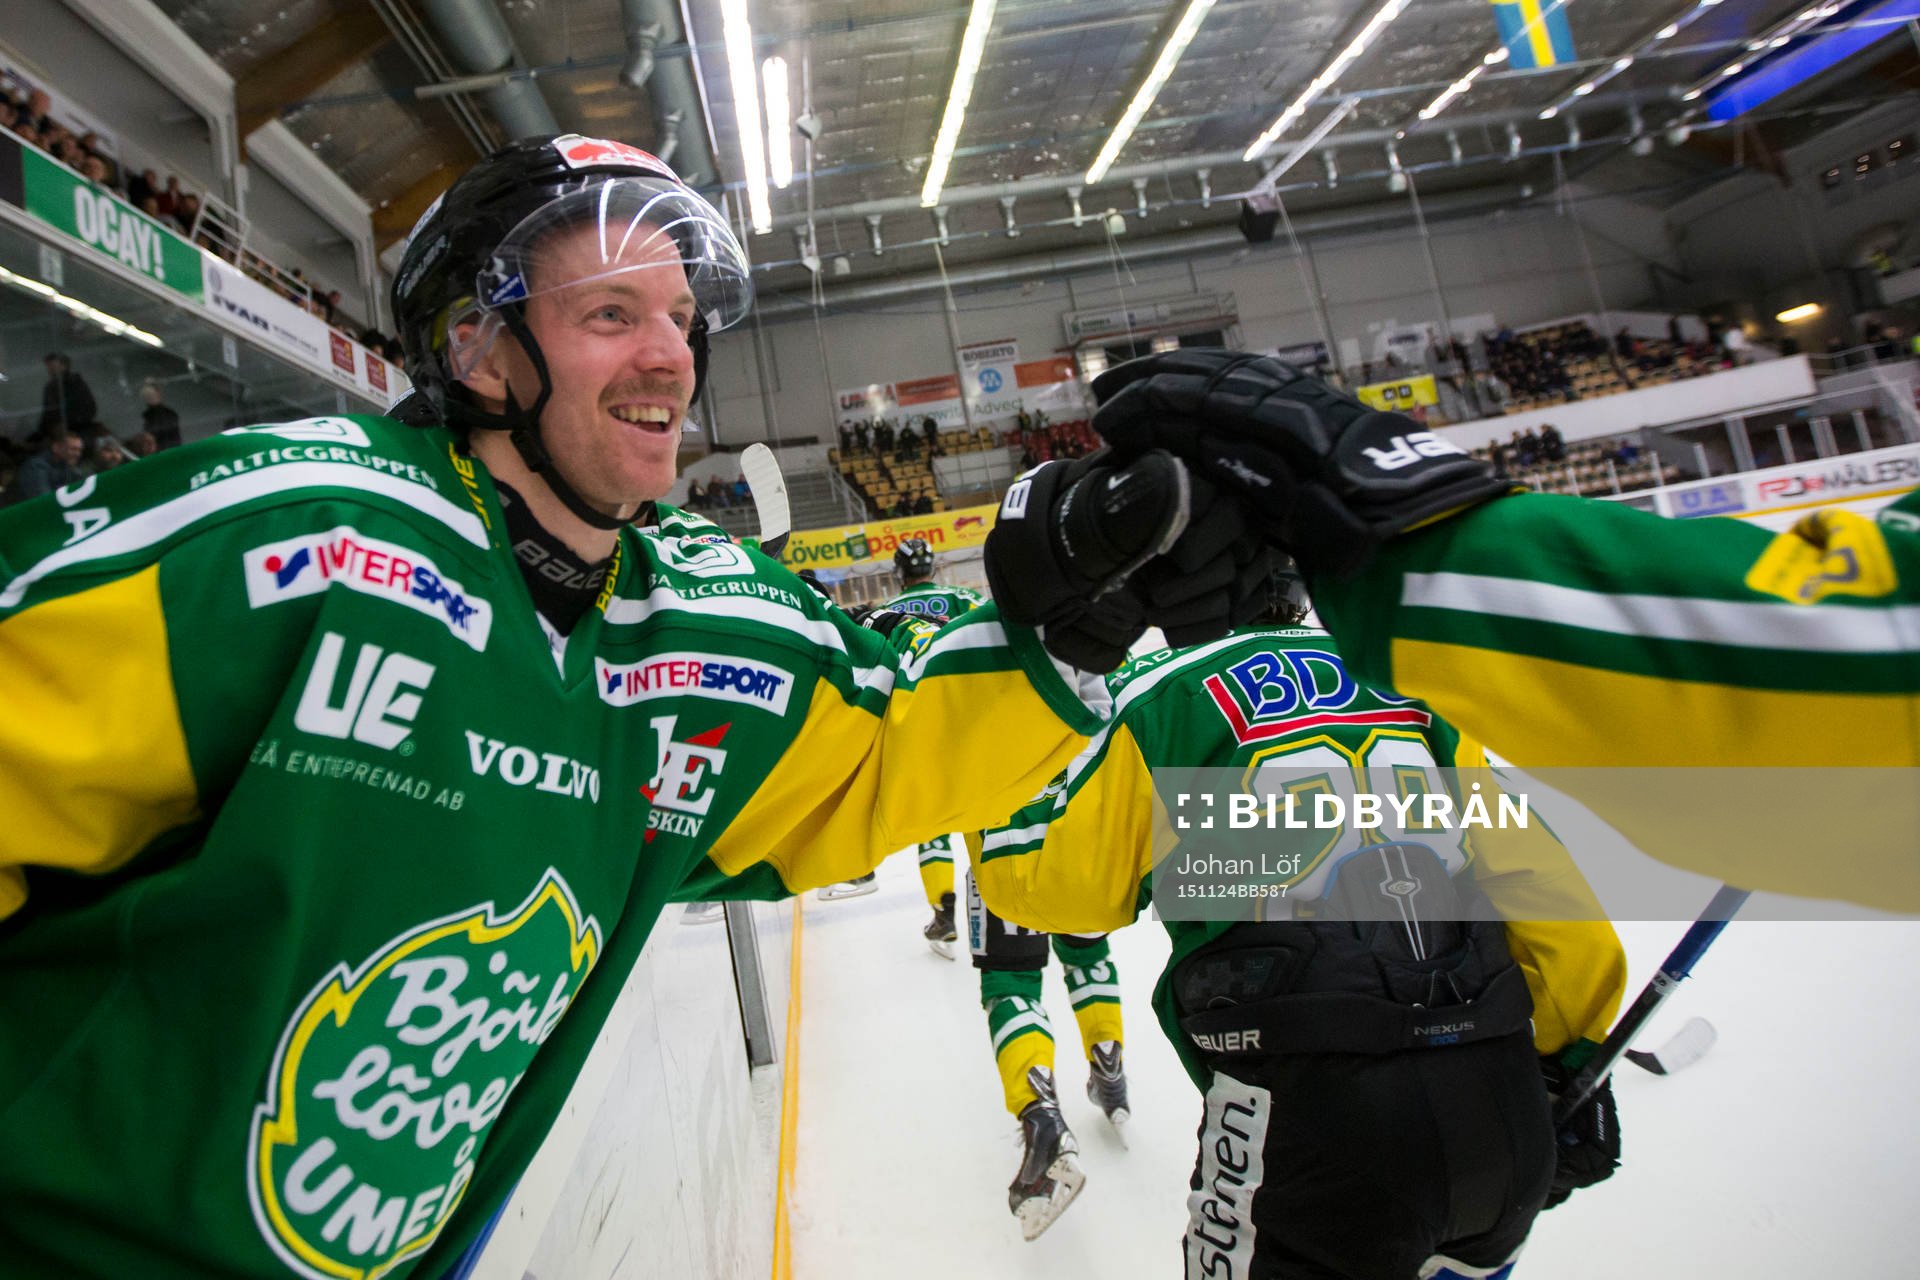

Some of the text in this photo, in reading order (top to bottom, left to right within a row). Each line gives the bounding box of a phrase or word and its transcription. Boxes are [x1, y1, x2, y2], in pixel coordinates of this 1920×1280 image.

[74, 185, 166, 281] OCAY!
[963, 346, 1015, 361] ROBERTO
[190, 446, 438, 490] BALTICGRUPPEN
[649, 573, 802, 609] BATICGRUPPEN
[294, 631, 437, 751] UE
[627, 661, 784, 701] INTERSPORT
[1227, 649, 1420, 720] BD
[465, 730, 600, 804] VOLVO
[433, 788, 466, 811] AB
[1413, 1021, 1475, 1036] NEXUS
[1193, 1097, 1257, 1280] stenen.
